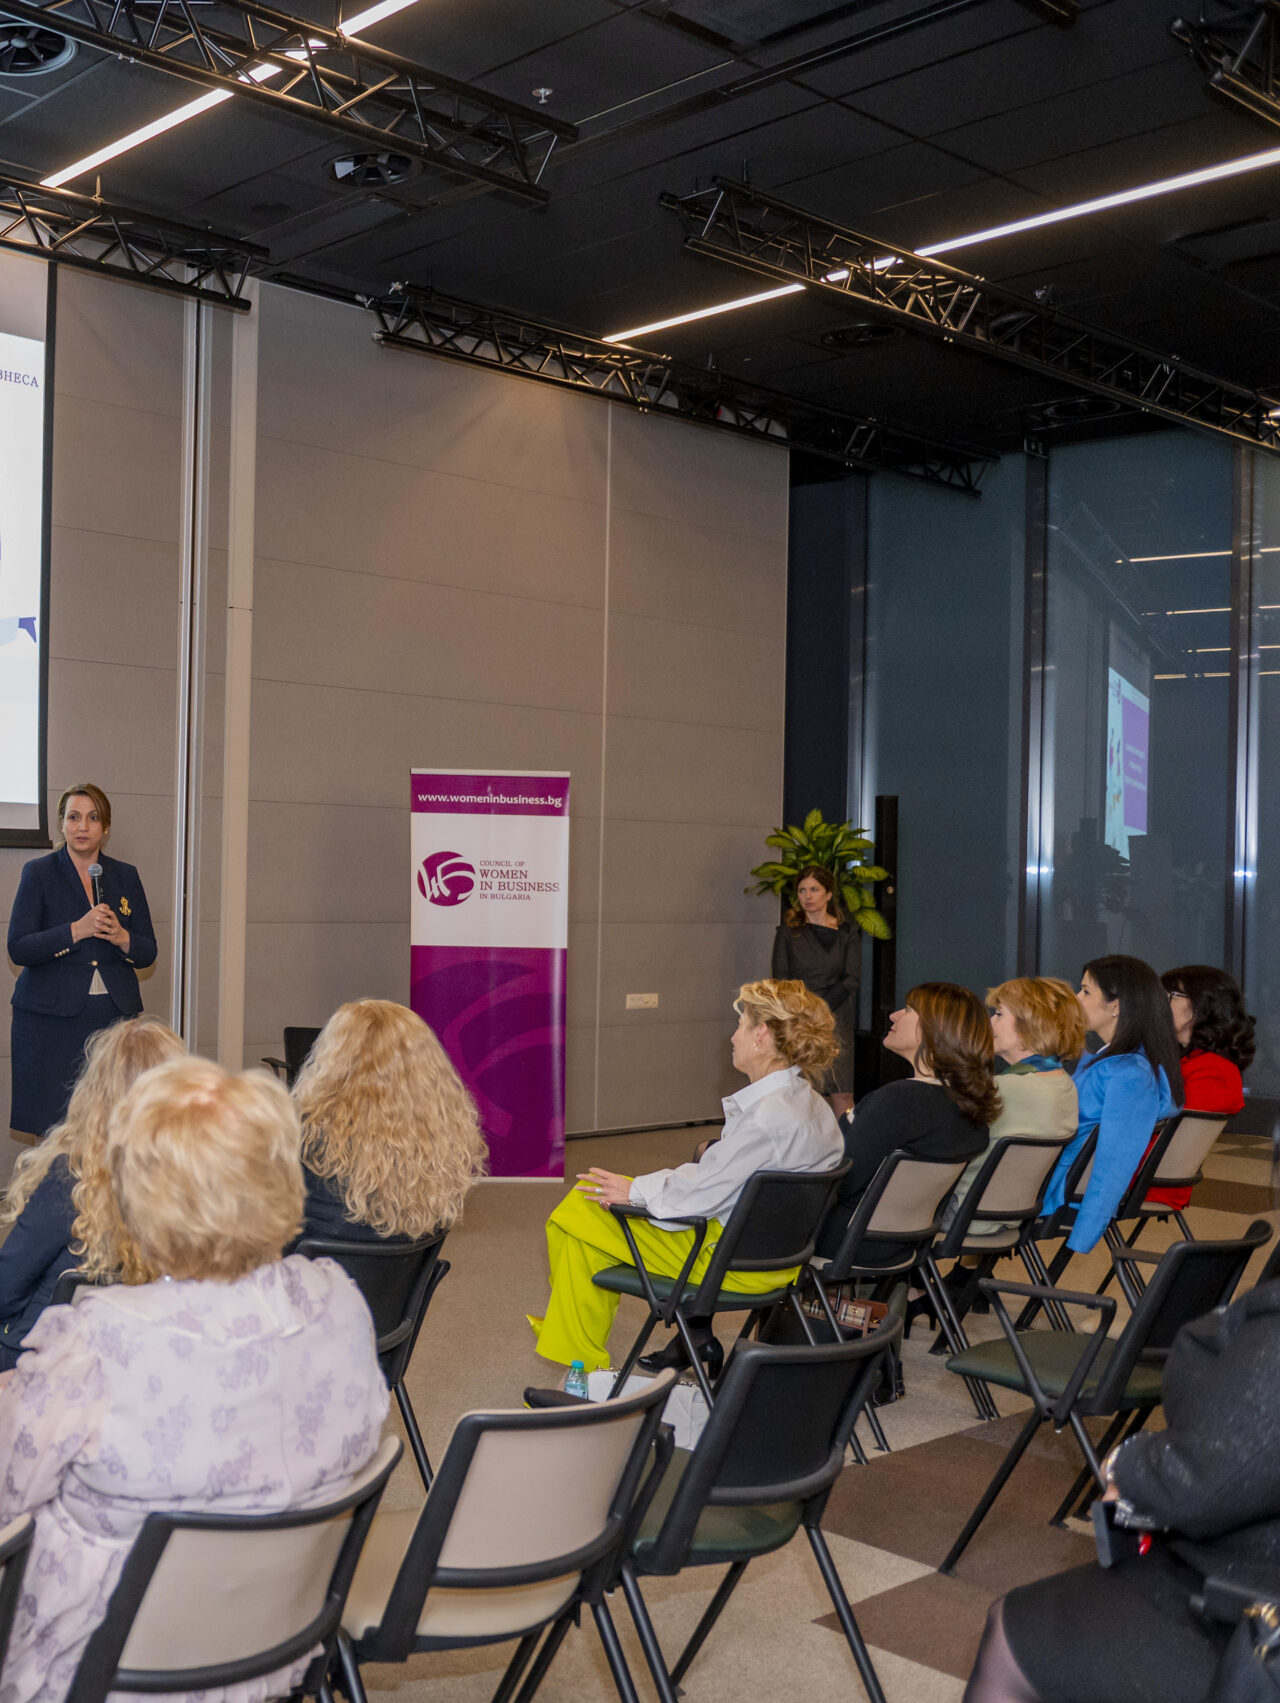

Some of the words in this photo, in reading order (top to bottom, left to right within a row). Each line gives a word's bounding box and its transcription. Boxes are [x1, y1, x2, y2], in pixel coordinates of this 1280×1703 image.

[417, 793, 563, 808] www.womeninbusiness.bg
[479, 869, 528, 879] WOMEN
[479, 881, 493, 891] IN
[497, 881, 560, 892] BUSINESS
[490, 893, 531, 901] BULGARIA
